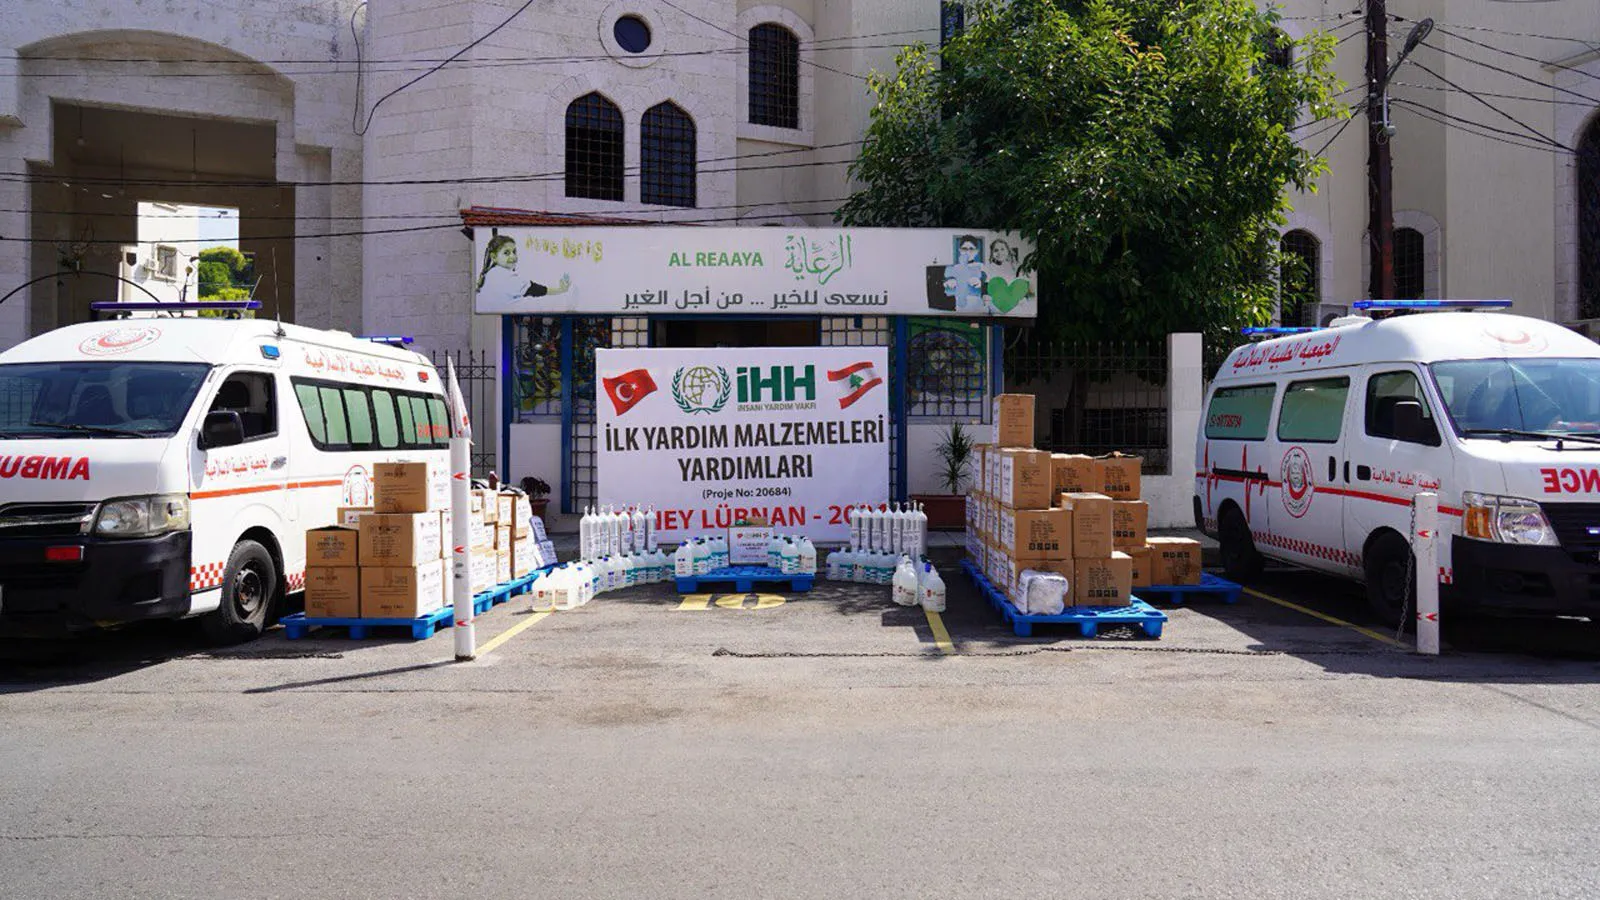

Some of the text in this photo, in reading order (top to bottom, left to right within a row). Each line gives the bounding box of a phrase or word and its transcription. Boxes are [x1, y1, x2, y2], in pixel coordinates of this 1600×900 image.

[668, 252, 764, 267] AL REAAYA
[621, 289, 668, 310] الغير
[674, 286, 710, 310] أجل
[716, 291, 744, 310] من
[770, 290, 818, 310] للخير
[823, 289, 889, 306] نسعى
[605, 414, 885, 452] İLK YARDIM MALZEMELERİ
[678, 454, 813, 482] YARDIMLARI
[702, 487, 792, 500] (Proje No: 20684)
